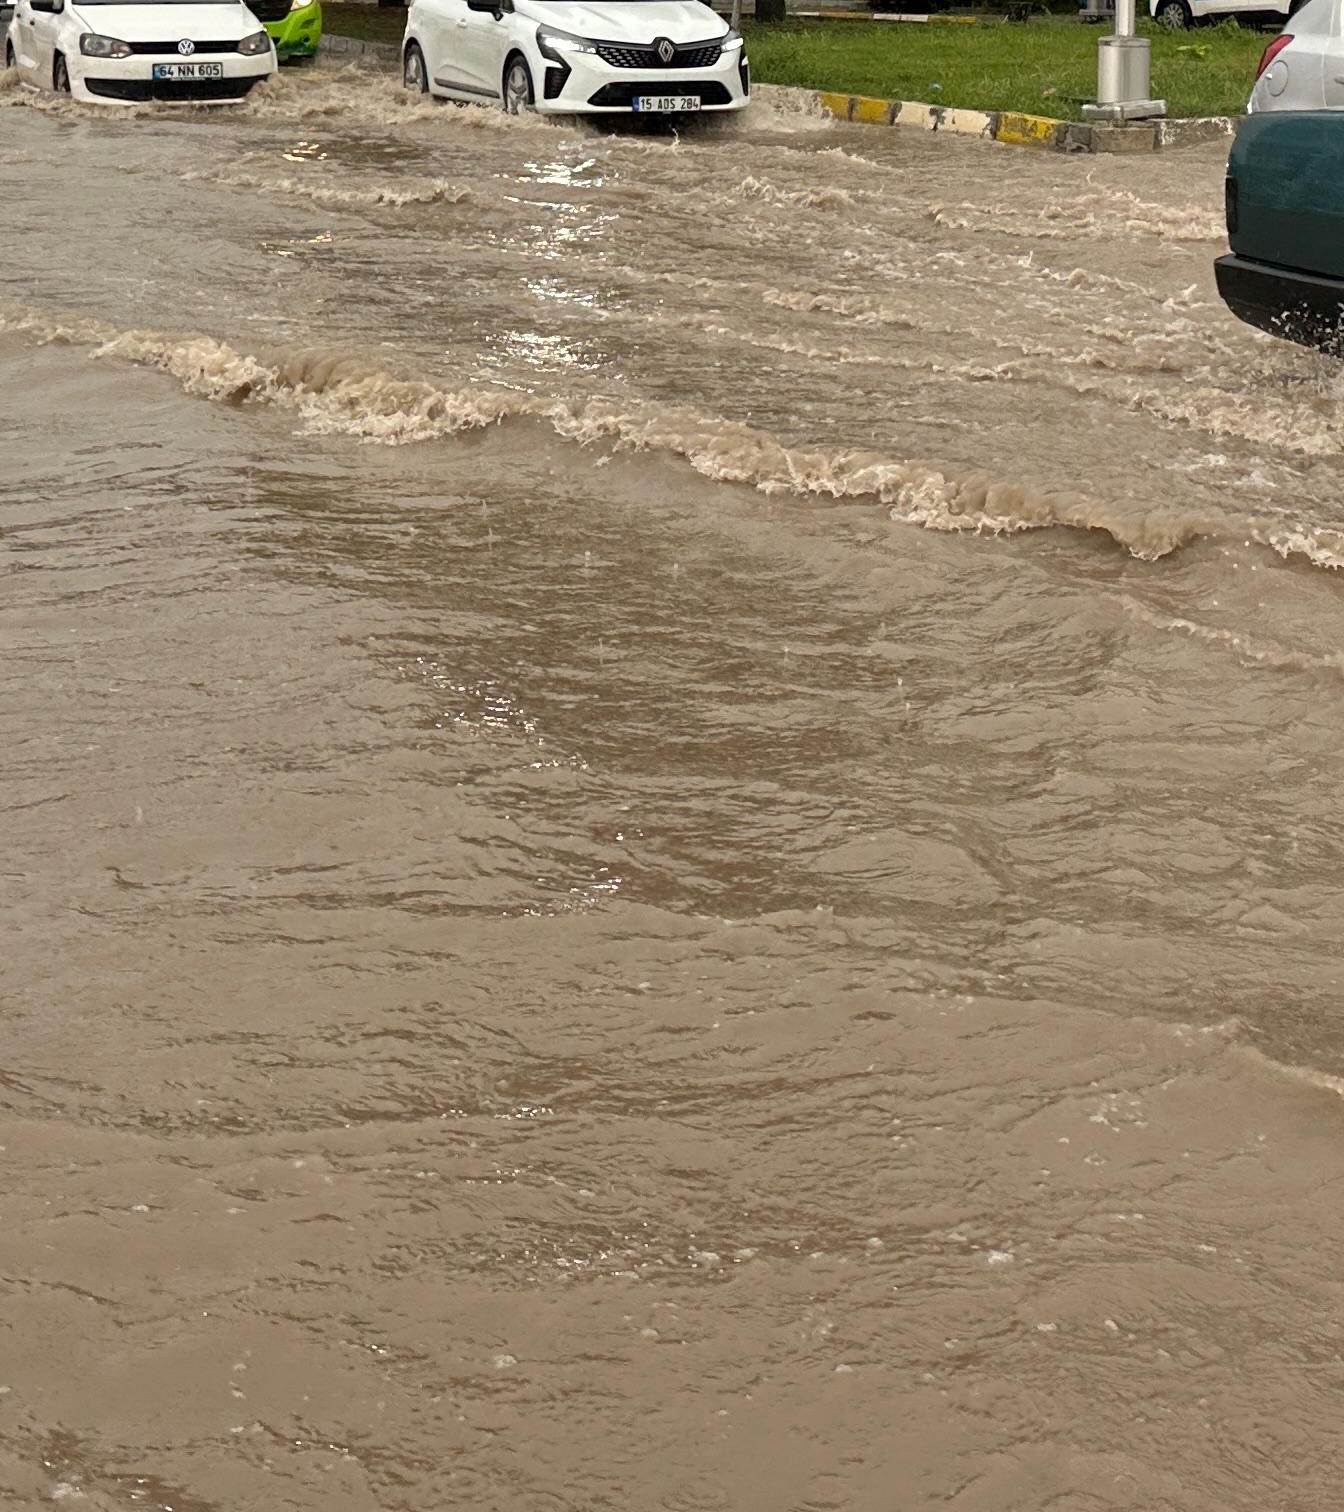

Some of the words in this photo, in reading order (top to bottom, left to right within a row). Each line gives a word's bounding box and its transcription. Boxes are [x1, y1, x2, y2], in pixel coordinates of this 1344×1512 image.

[159, 66, 174, 77] 64
[178, 65, 195, 77] NN
[198, 64, 220, 76] 605
[641, 98, 652, 110] 15
